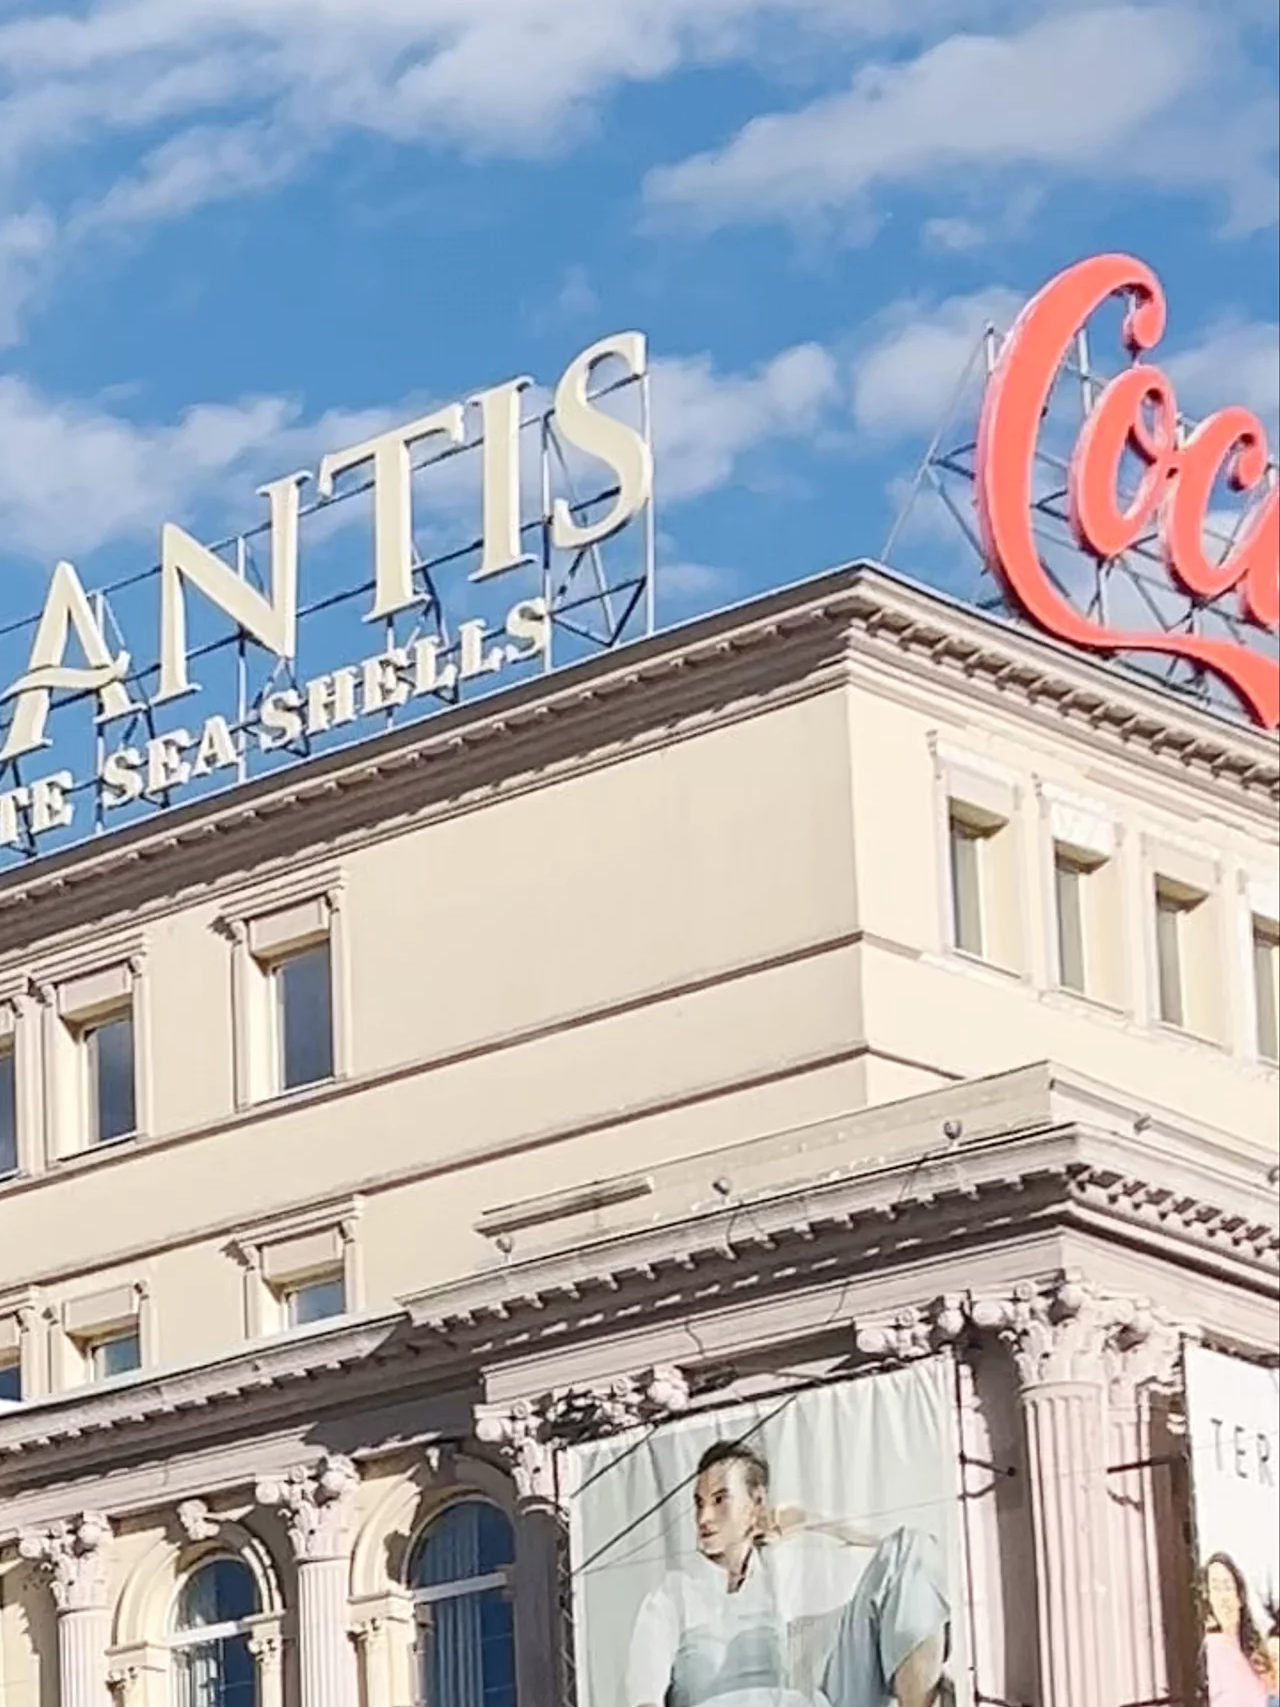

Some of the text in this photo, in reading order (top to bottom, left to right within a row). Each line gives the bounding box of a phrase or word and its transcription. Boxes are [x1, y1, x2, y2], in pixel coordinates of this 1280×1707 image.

[977, 252, 1280, 730] Coc
[100, 713, 241, 805] SEA
[258, 595, 553, 753] SHELLS
